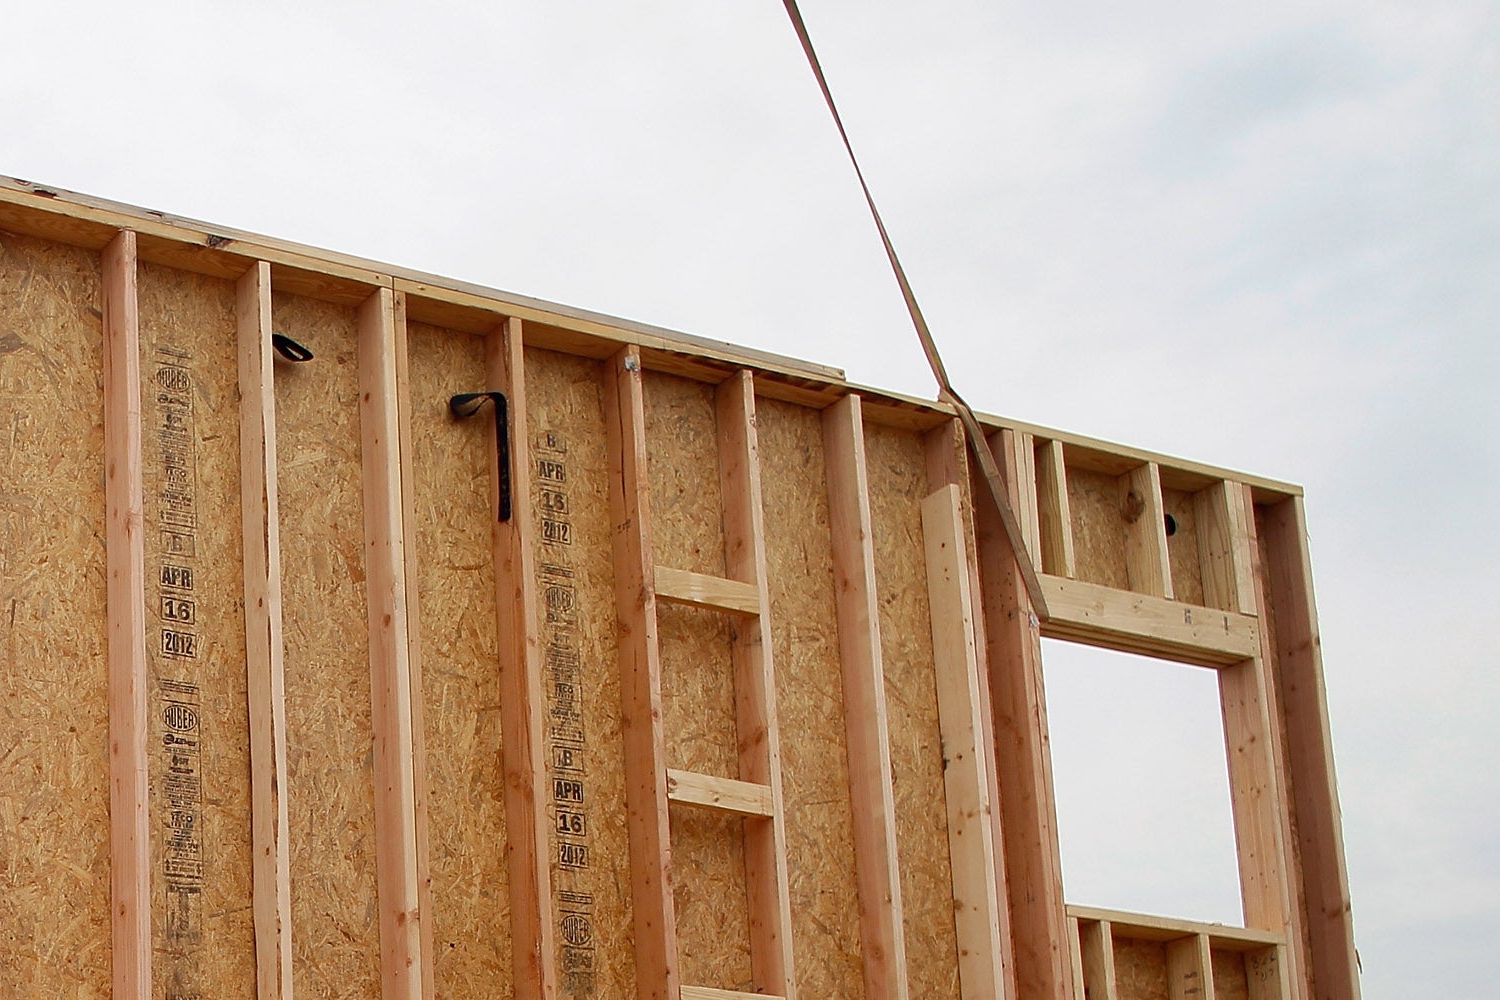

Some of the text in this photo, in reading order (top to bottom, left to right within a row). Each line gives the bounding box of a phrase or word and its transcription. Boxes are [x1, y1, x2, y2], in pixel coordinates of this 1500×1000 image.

[158, 369, 189, 391] HUBER
[540, 462, 565, 480] APR
[543, 494, 565, 510] 16
[543, 522, 568, 543] 2012
[162, 567, 192, 587] APR
[546, 588, 574, 610] HUBER
[164, 600, 190, 621] 16
[165, 632, 194, 655] 2012
[165, 706, 196, 731] HUBER
[563, 750, 573, 764] B
[556, 782, 582, 800] APR
[559, 814, 582, 832] 16
[561, 845, 586, 866] 2012
[563, 916, 590, 943] HUBER
